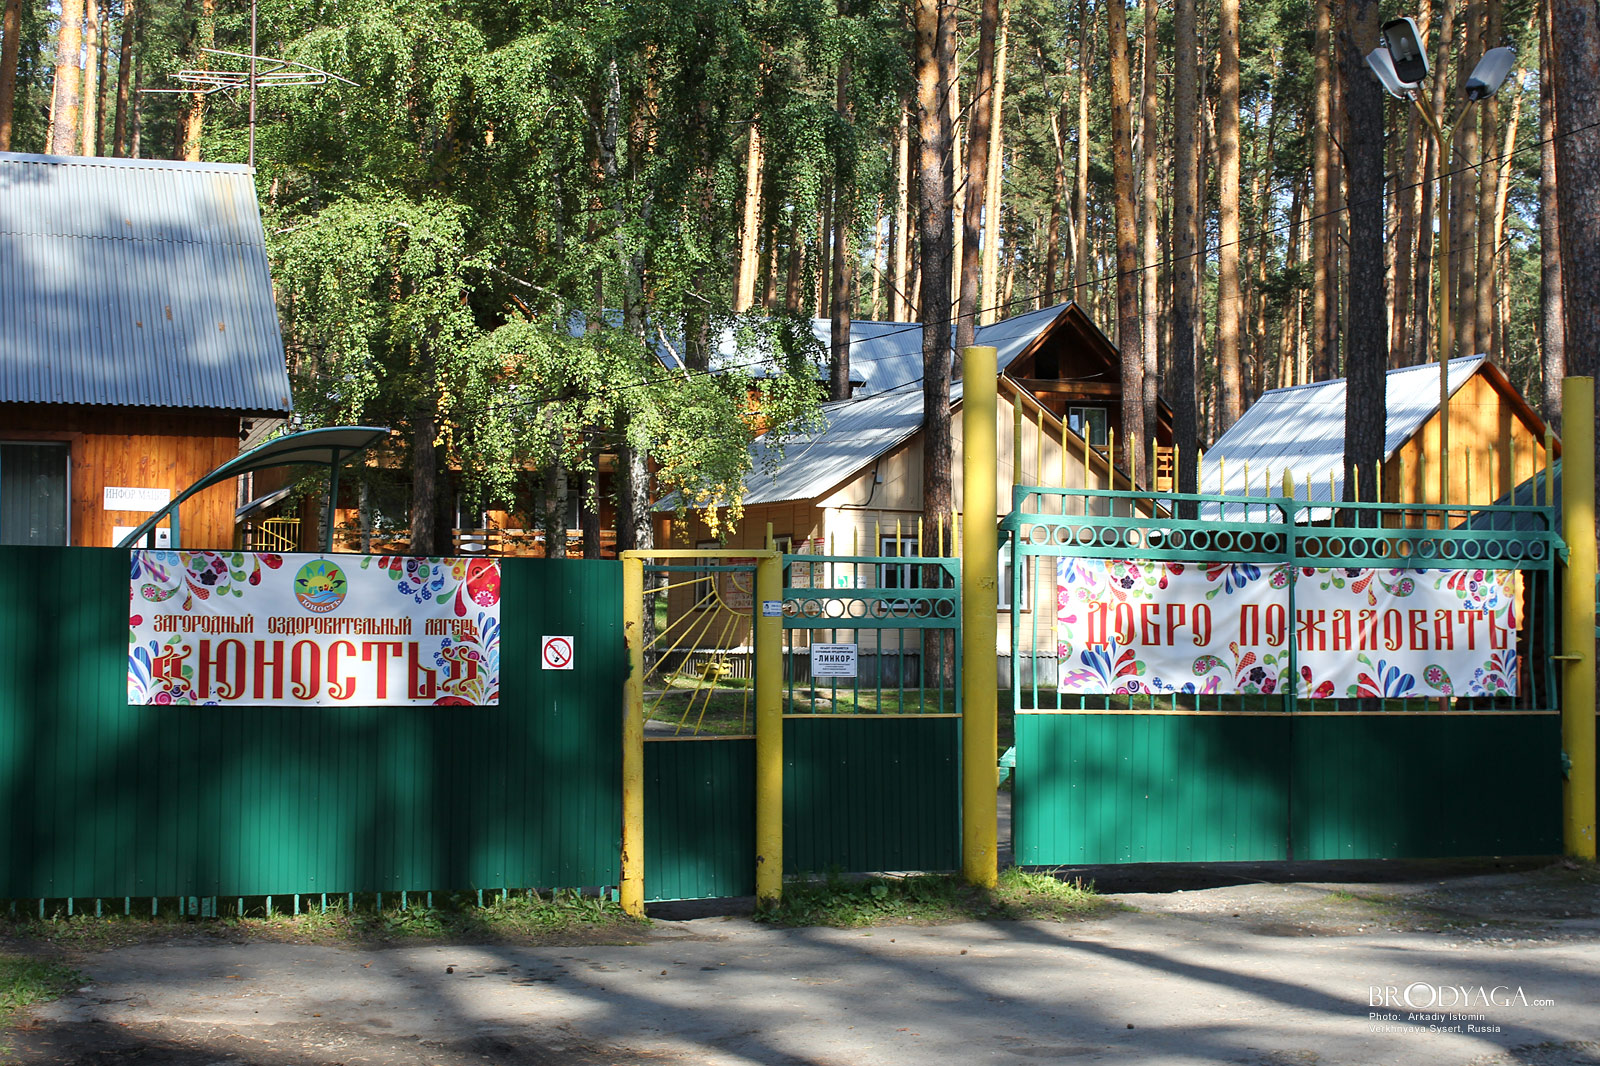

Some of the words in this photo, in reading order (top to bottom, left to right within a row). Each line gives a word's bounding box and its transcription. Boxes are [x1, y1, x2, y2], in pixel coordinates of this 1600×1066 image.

[153, 614, 254, 635] ЗАГОРОДНЫЙ
[268, 616, 412, 636] ОЗДОРОВИТЕЛЬНЫЙ
[425, 618, 478, 636] ЛАГЕРЬ
[1085, 601, 1212, 652] ДОБРО
[1239, 603, 1509, 651] ПОЖАЛОВАТЬ
